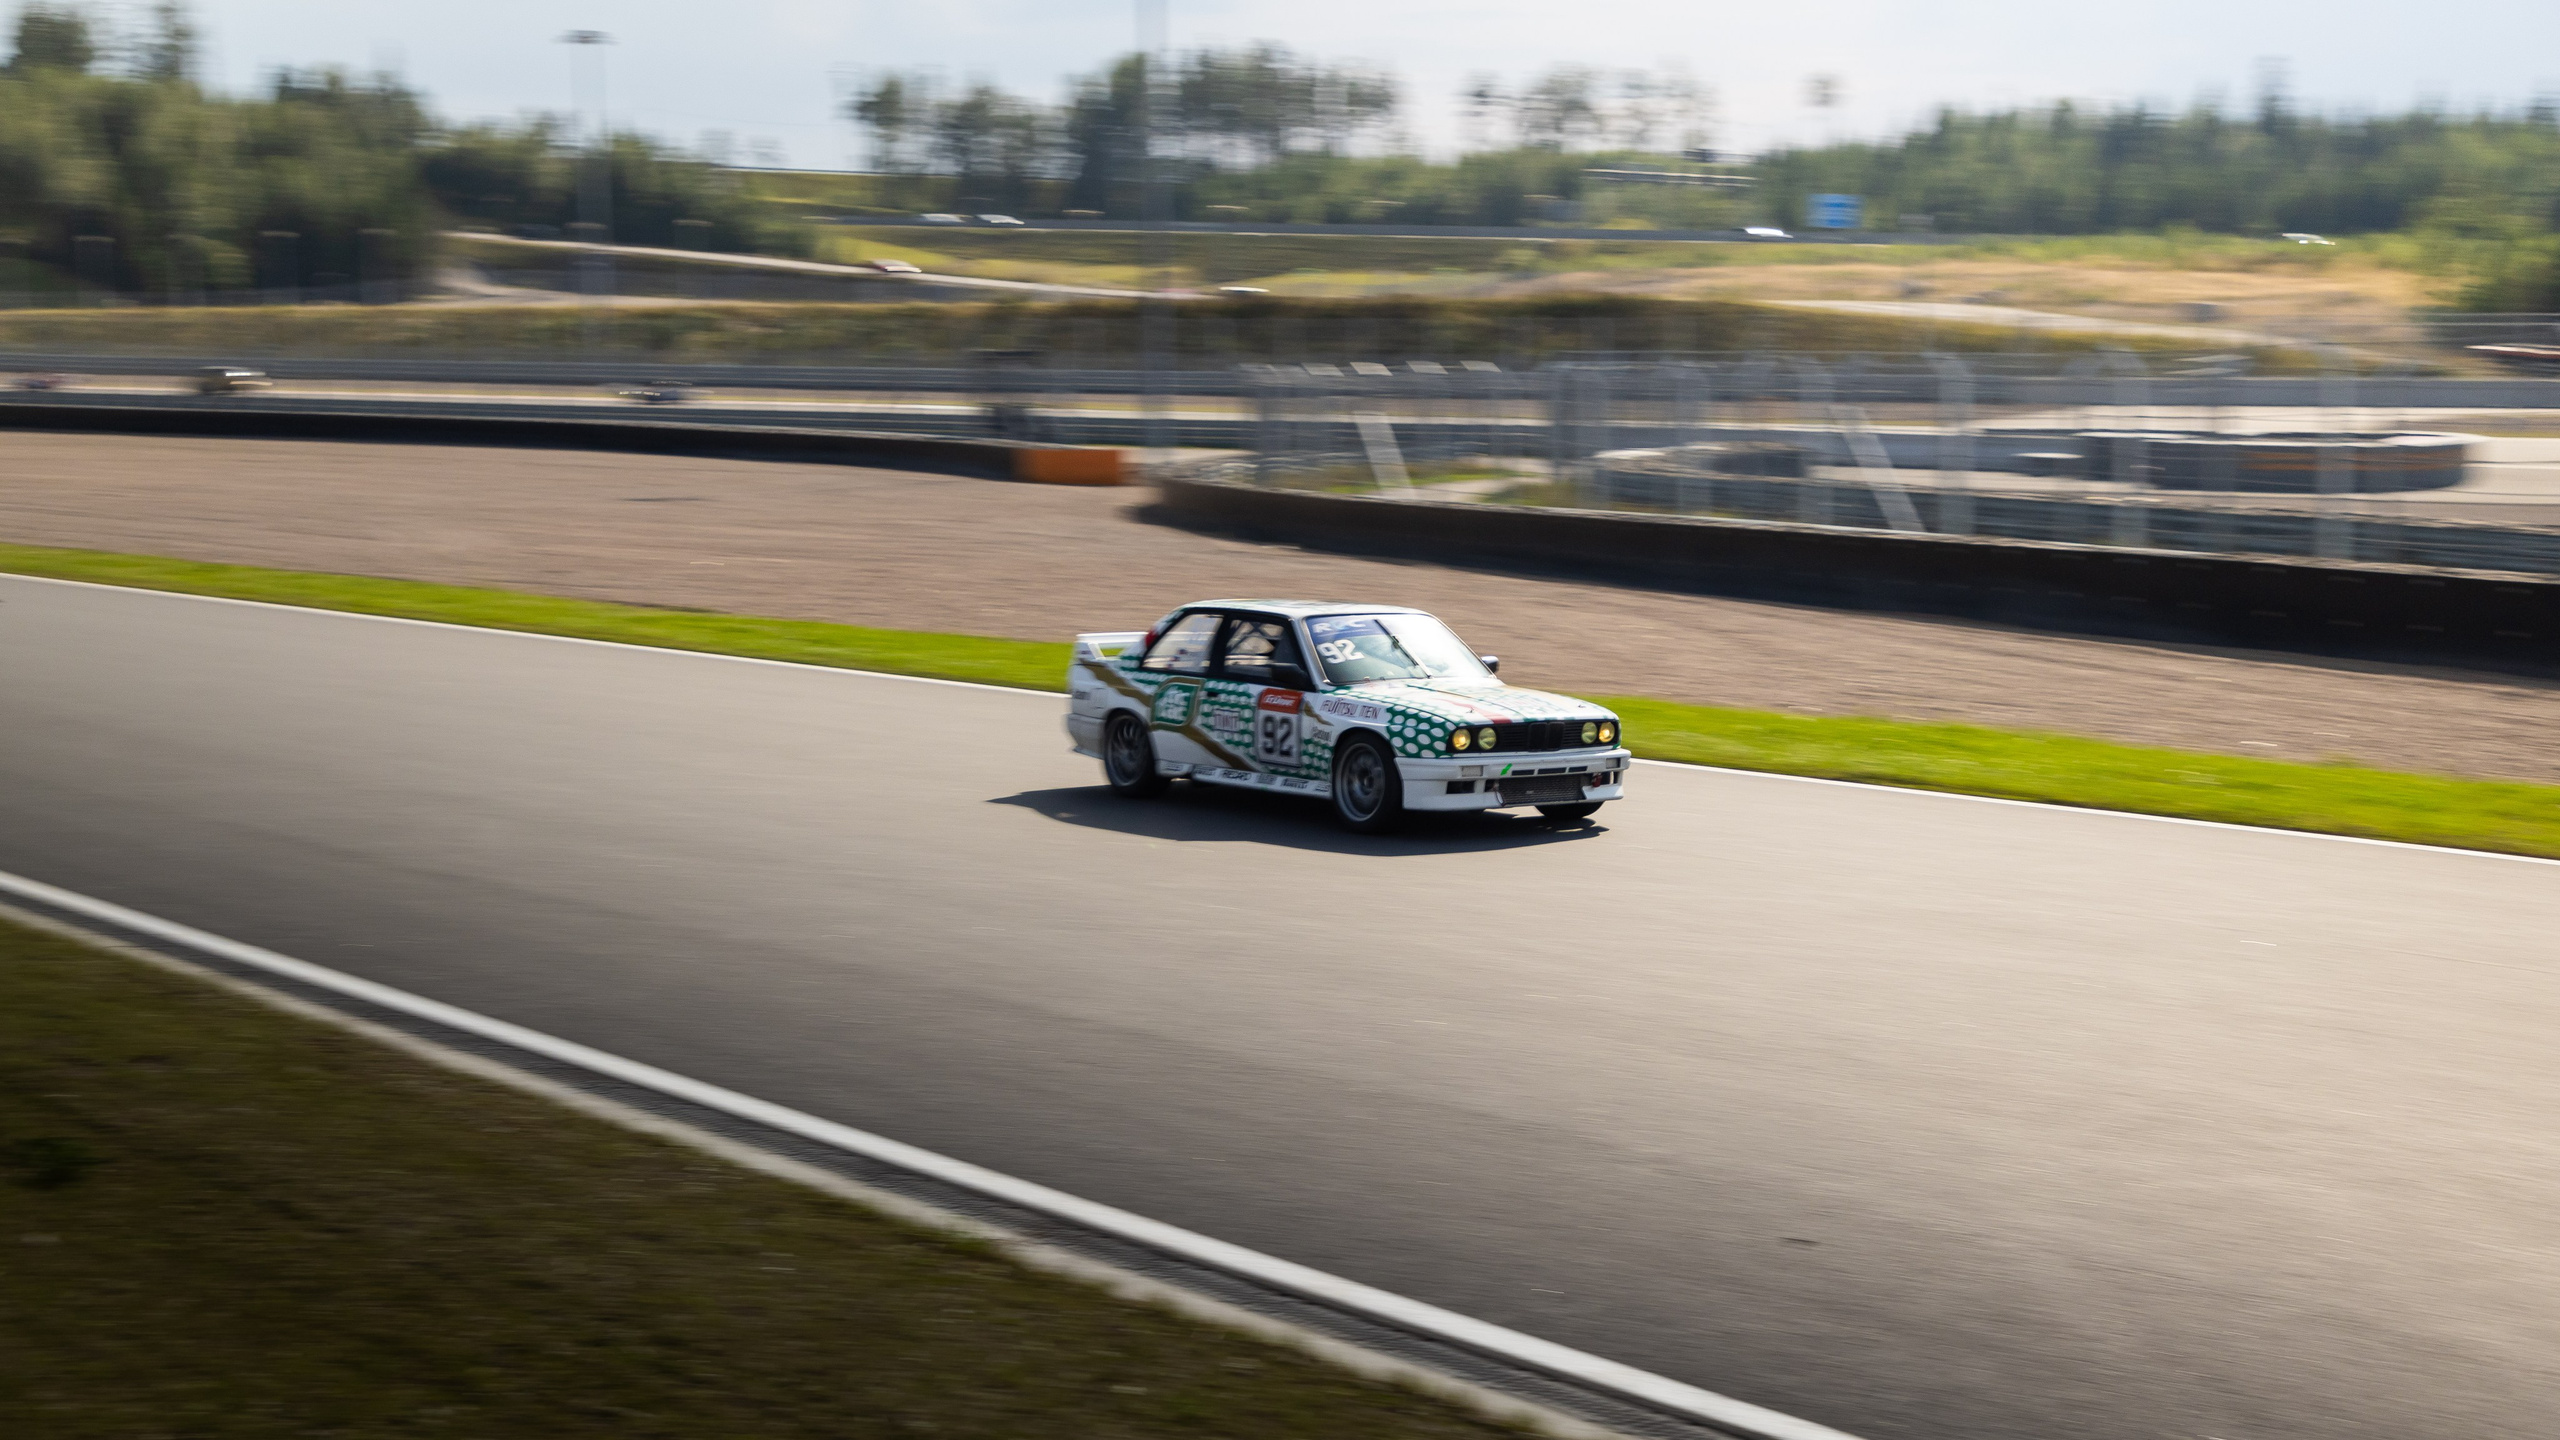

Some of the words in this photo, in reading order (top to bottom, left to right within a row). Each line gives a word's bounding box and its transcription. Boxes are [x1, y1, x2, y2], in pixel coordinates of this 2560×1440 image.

[1316, 639, 1365, 664] 92
[1319, 699, 1359, 716] FUJITSU
[1360, 705, 1381, 719] TEN
[1262, 715, 1294, 757] 92
